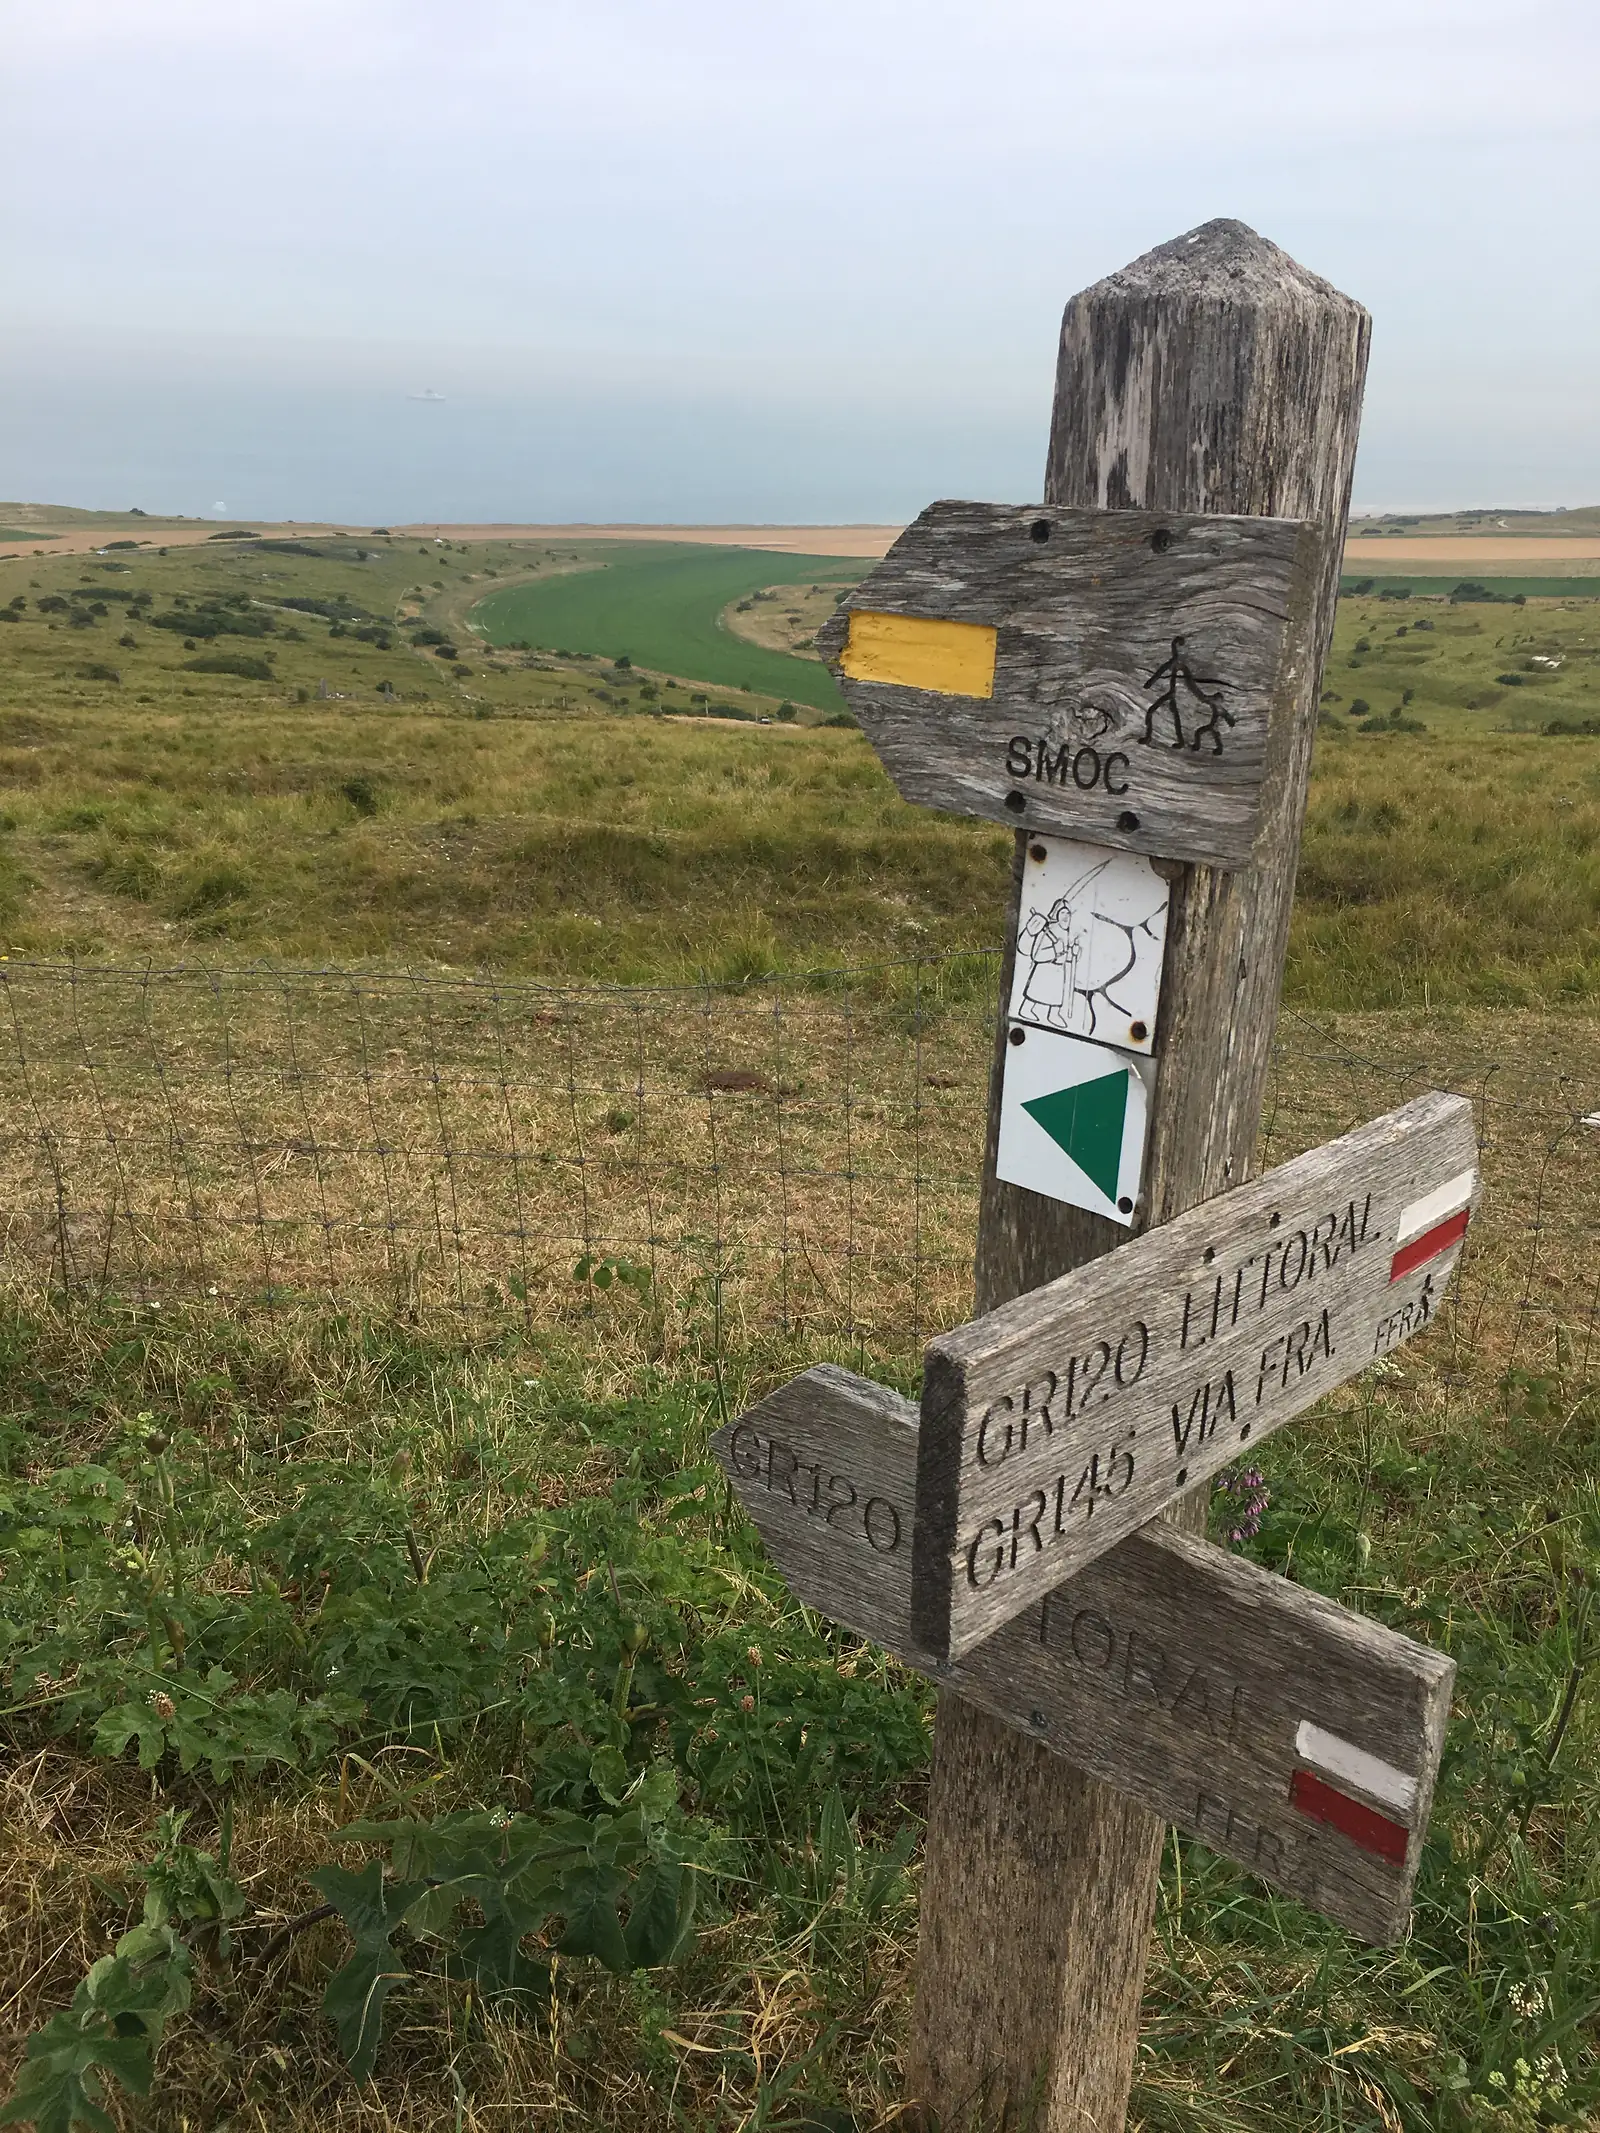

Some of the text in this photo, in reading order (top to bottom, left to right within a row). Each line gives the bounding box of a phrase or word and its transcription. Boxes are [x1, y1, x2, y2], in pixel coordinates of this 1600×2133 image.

[1005, 735, 1130, 796] SMOC
[976, 1192, 1381, 1466] GR120 LITTORAL
[730, 1424, 901, 1552] GR120
[966, 1430, 1137, 1590] GR145
[1171, 1369, 1236, 1457] VIA
